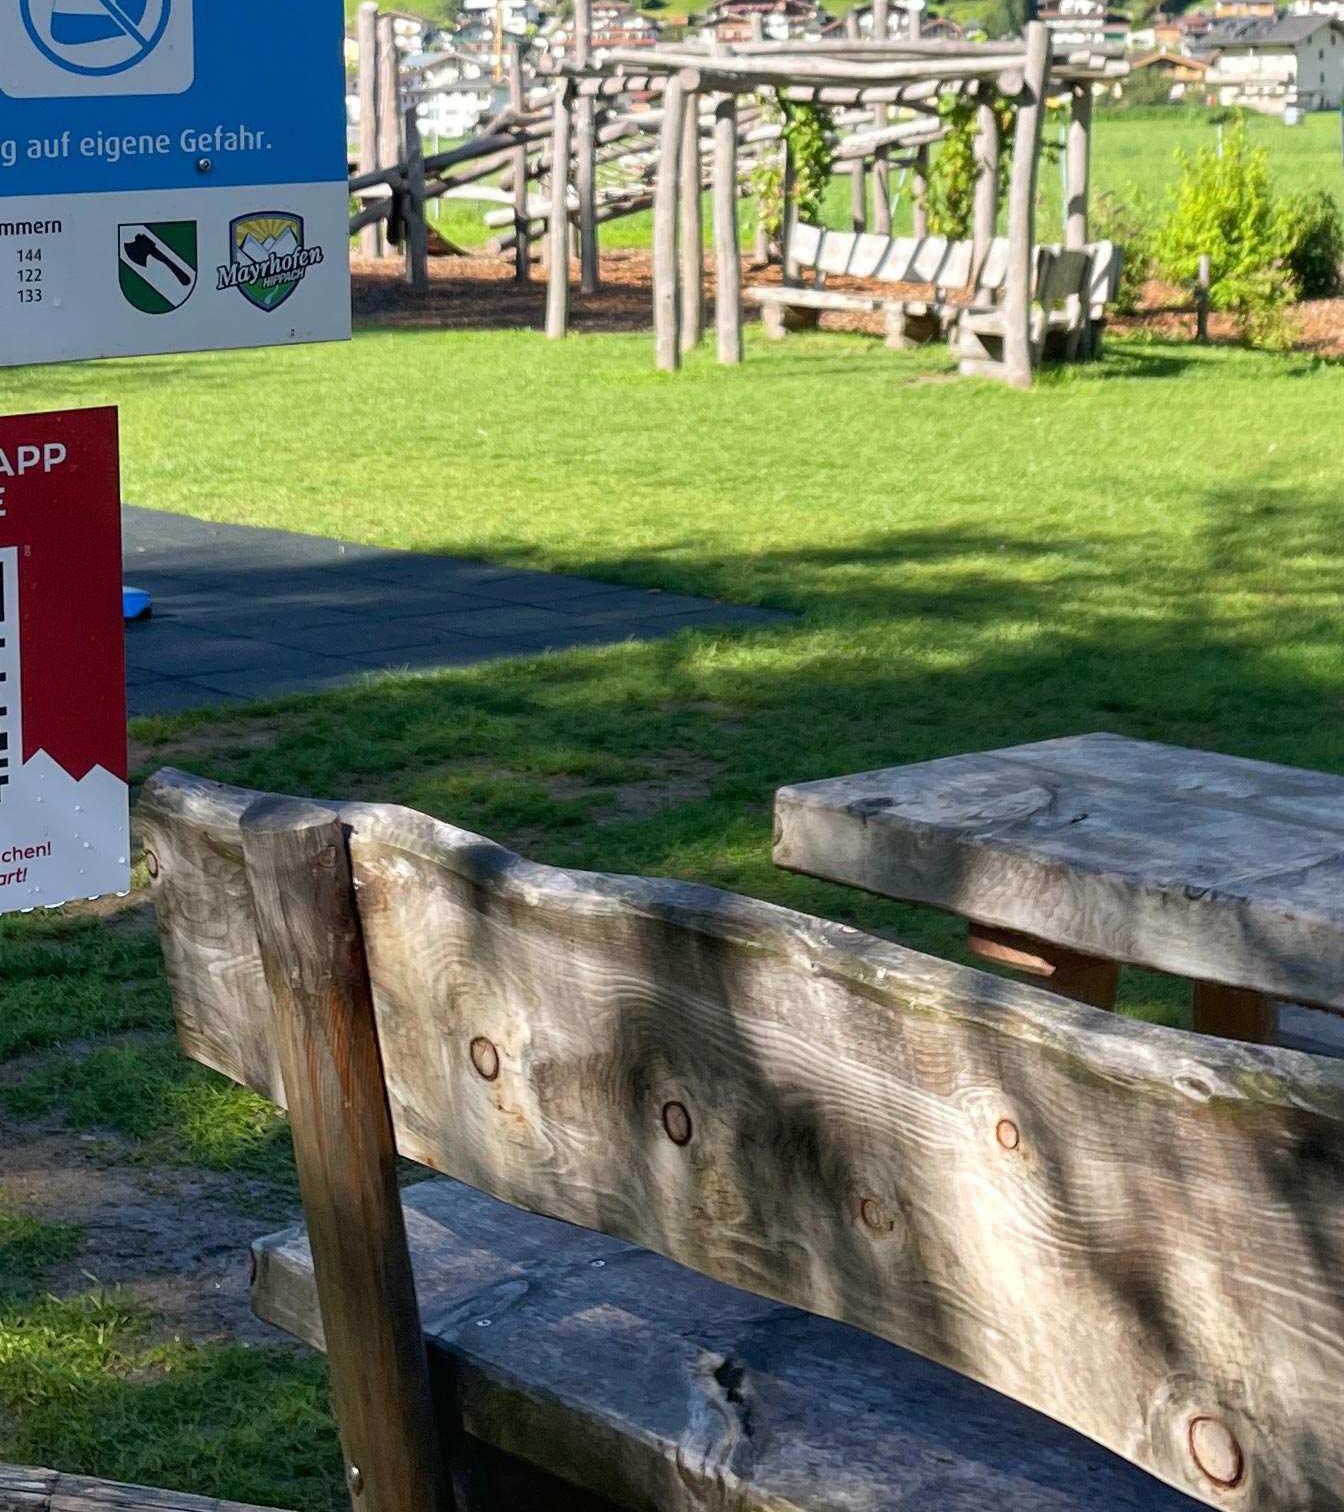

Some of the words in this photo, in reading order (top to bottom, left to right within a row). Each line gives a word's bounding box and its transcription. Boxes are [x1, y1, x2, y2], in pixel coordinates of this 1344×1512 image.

[26, 131, 72, 160] auf
[79, 129, 171, 163] eigene
[179, 124, 273, 154] Gefahr.
[16, 248, 42, 262] 144
[17, 268, 42, 282] 122
[217, 247, 323, 289] Mayrhofen
[262, 267, 305, 289] HIPPACH
[17, 289, 42, 303] 133
